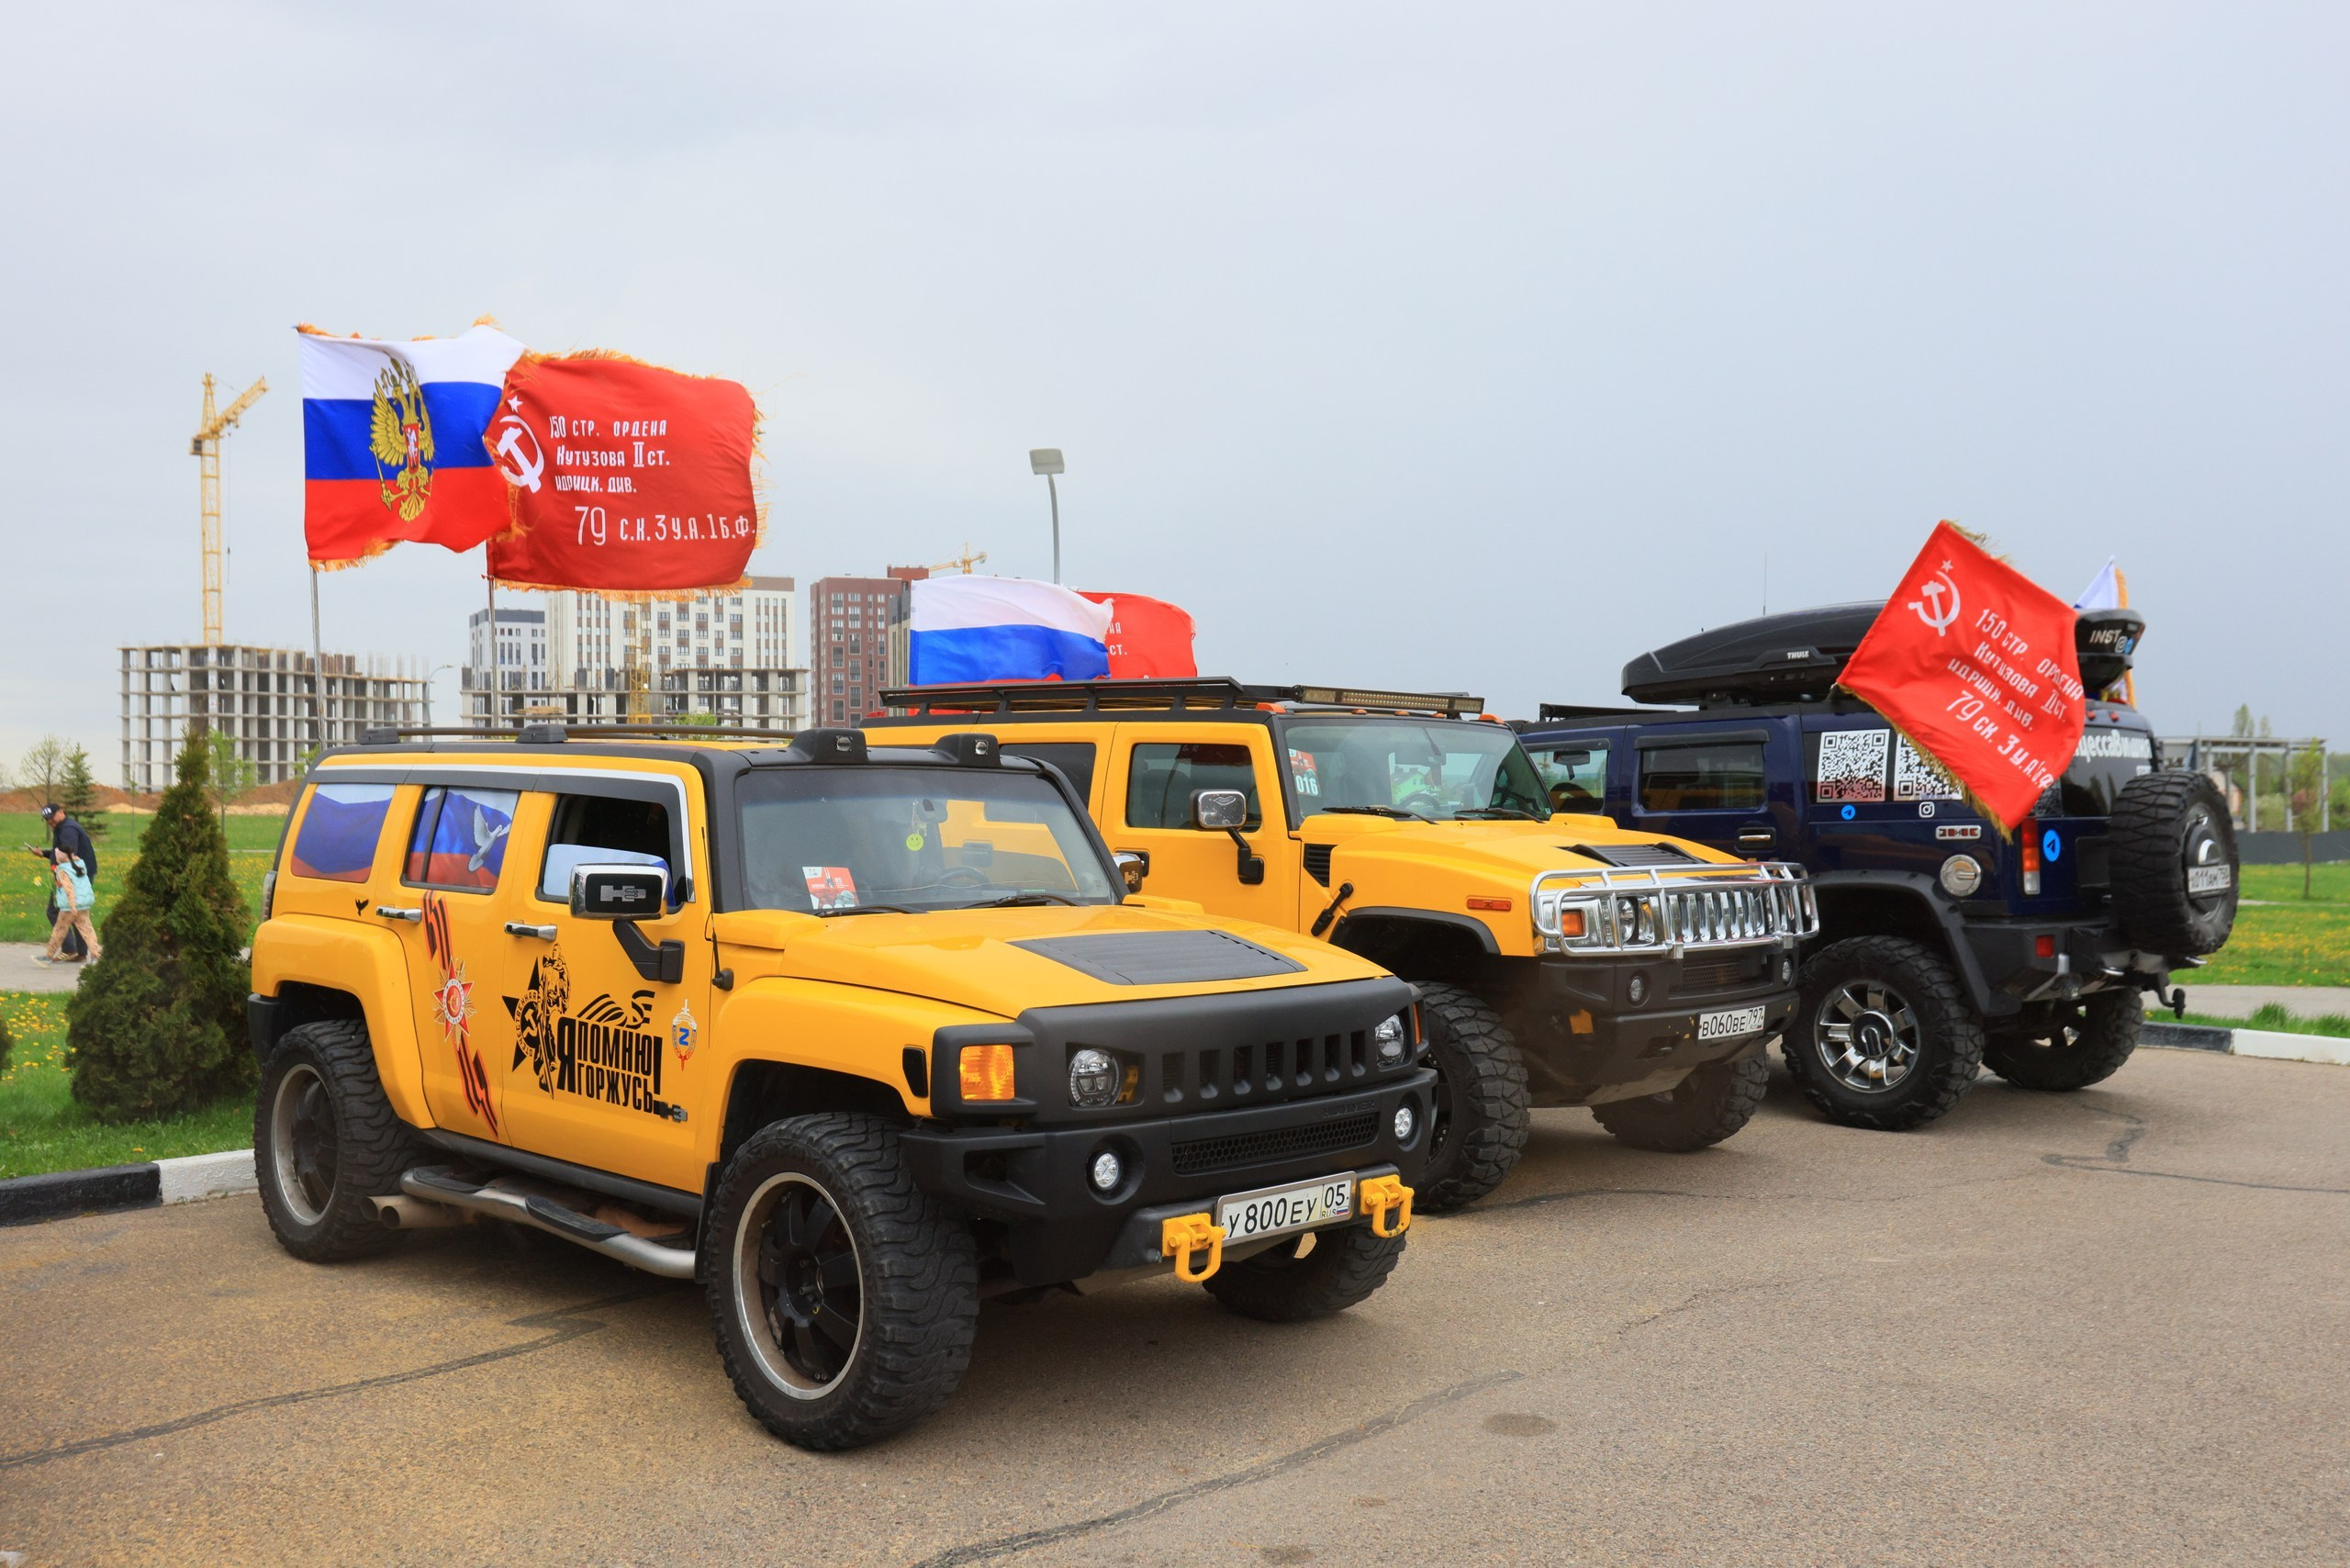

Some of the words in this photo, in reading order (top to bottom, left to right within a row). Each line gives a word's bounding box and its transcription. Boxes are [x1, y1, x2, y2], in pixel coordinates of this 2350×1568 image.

[548, 416, 566, 438] 150
[575, 506, 606, 546] 79
[1975, 609, 2008, 639] 150
[1786, 650, 1809, 659] THULE
[1946, 690, 1985, 721] 79
[1295, 776, 1319, 795] 016
[1702, 1014, 1746, 1036] В060ВЕ
[1748, 1008, 1762, 1025] 797
[1325, 1183, 1346, 1208] 05
[1321, 1208, 1337, 1218] RUS
